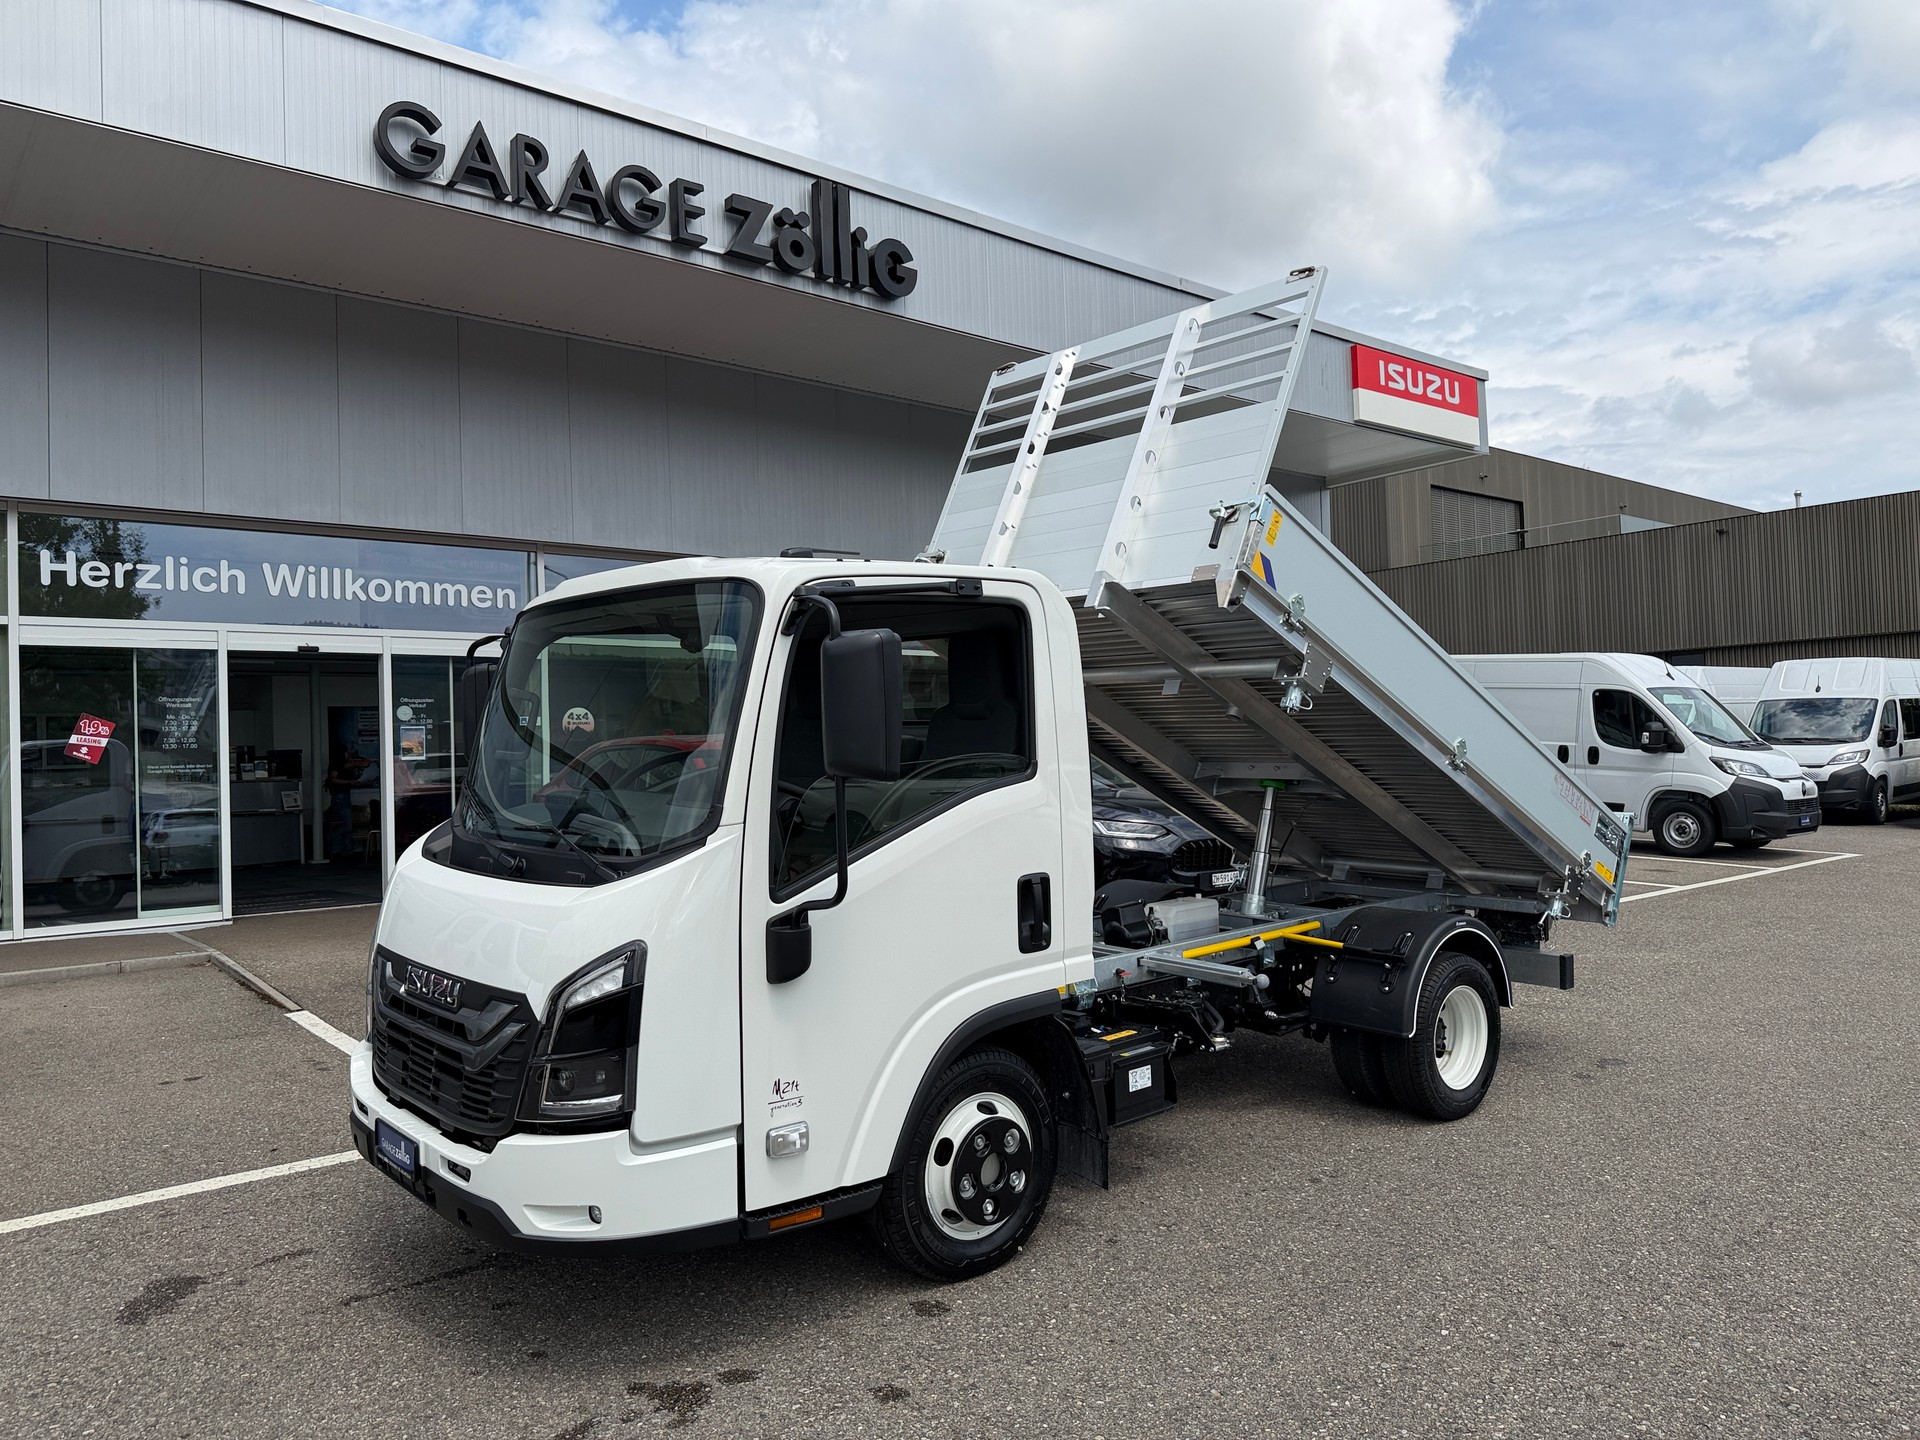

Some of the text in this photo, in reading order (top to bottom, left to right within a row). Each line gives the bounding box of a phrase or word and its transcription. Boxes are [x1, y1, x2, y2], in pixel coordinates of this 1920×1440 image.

[372, 100, 708, 249] GARAGE
[1379, 359, 1460, 405] ISUZU
[39, 549, 516, 610] Herzlich Willkommen
[567, 712, 589, 721] 4x4
[76, 736, 102, 745] LEASING
[404, 965, 461, 1008] ISUZU
